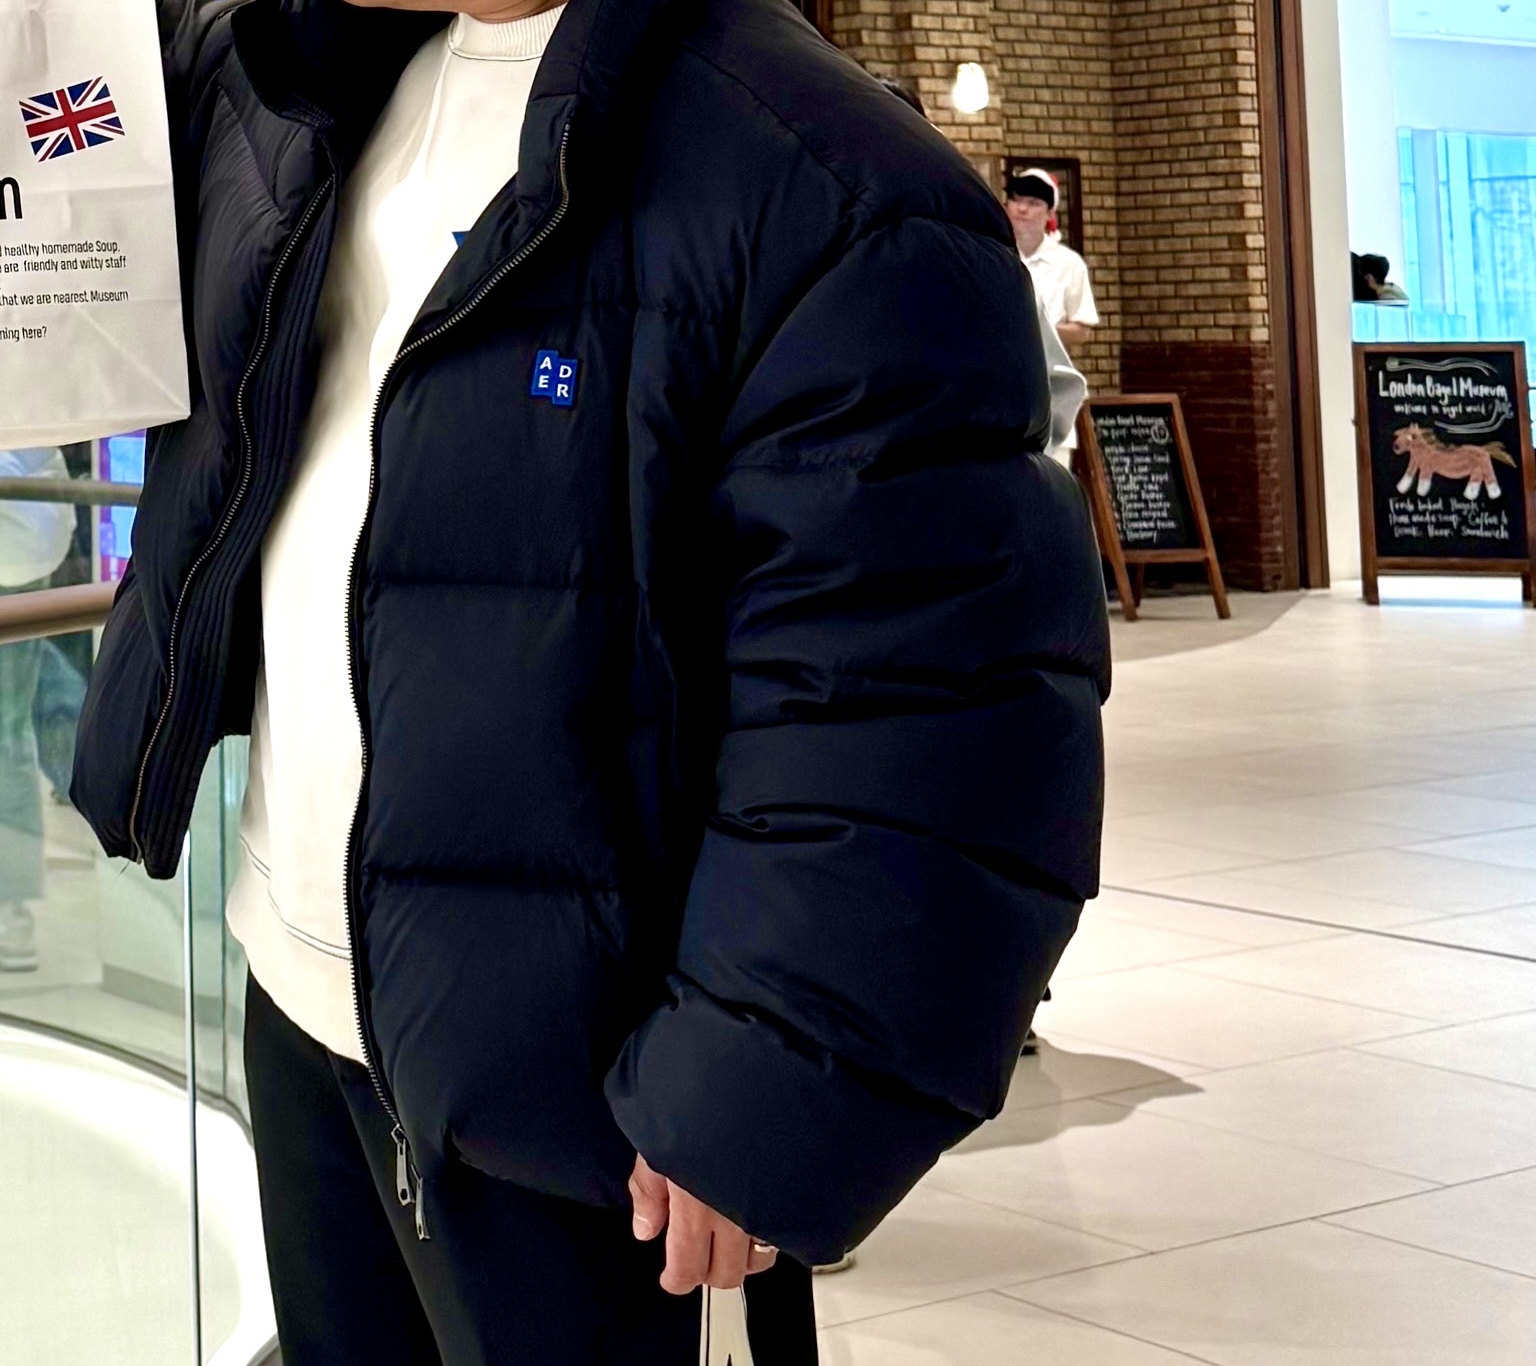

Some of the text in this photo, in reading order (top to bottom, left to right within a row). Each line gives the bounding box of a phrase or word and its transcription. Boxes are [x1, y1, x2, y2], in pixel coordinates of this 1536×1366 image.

[5, 243, 39, 256] healthy
[42, 240, 94, 254] homemade
[4, 263, 19, 273] are
[24, 259, 58, 272] friendly
[61, 258, 77, 270] and
[80, 256, 103, 270] witty
[105, 255, 126, 268] staff
[20, 295, 34, 305] we
[36, 294, 51, 304] are
[53, 290, 88, 304] nearest
[90, 290, 129, 302] Museum
[22, 326, 47, 338] here?
[1378, 370, 1508, 405] London Bagel Museum
